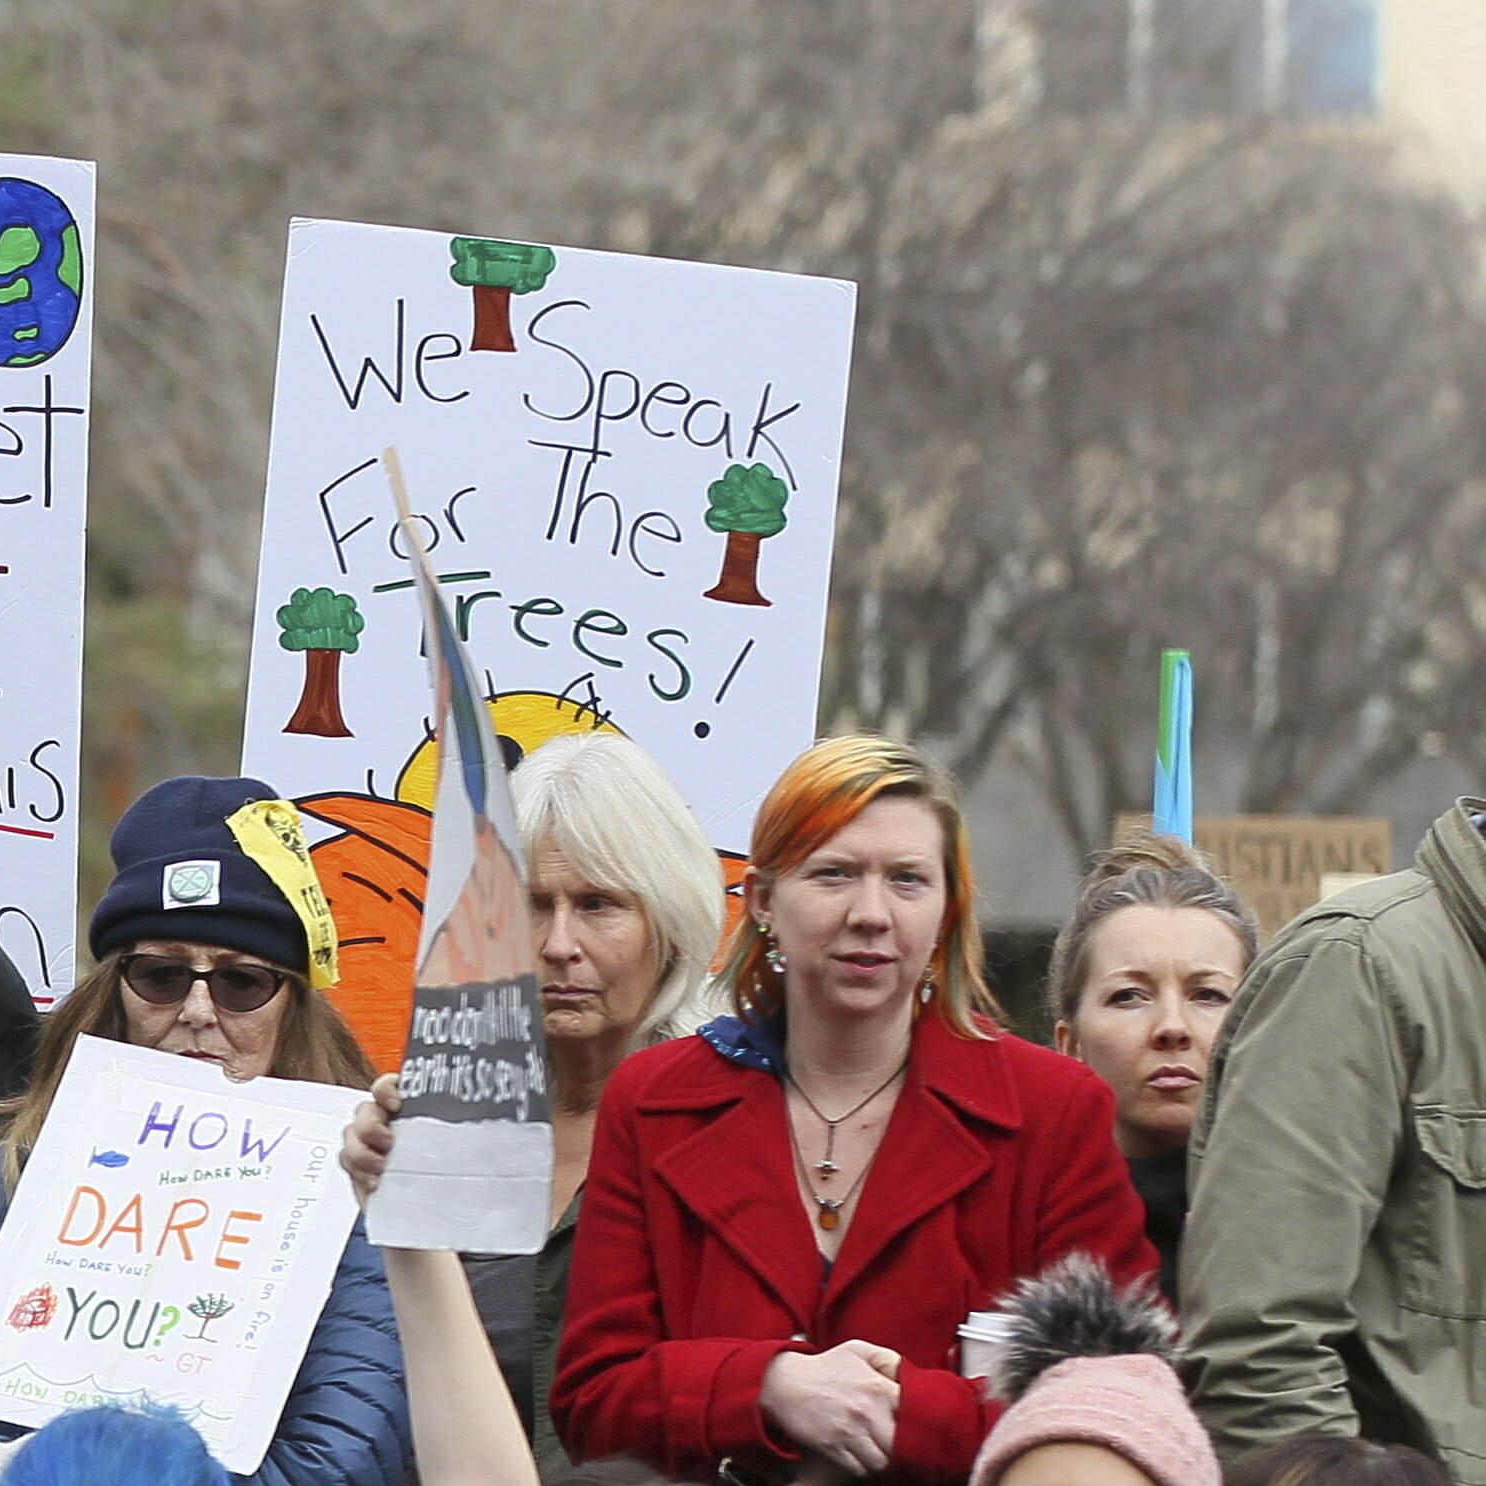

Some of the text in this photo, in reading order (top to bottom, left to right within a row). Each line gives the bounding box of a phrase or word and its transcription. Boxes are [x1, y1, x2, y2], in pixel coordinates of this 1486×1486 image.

[310, 297, 801, 492] We Speak
[318, 438, 683, 577] For The
[371, 570, 756, 739] Trees!
[137, 1100, 293, 1164] HOW
[192, 1166, 232, 1183] DARE
[56, 1184, 264, 1271] DARE
[279, 1196, 319, 1252] house
[79, 1257, 113, 1273] DARE
[259, 1282, 276, 1301] on
[63, 1286, 182, 1350] YOU?
[4, 1377, 49, 1400] HOW
